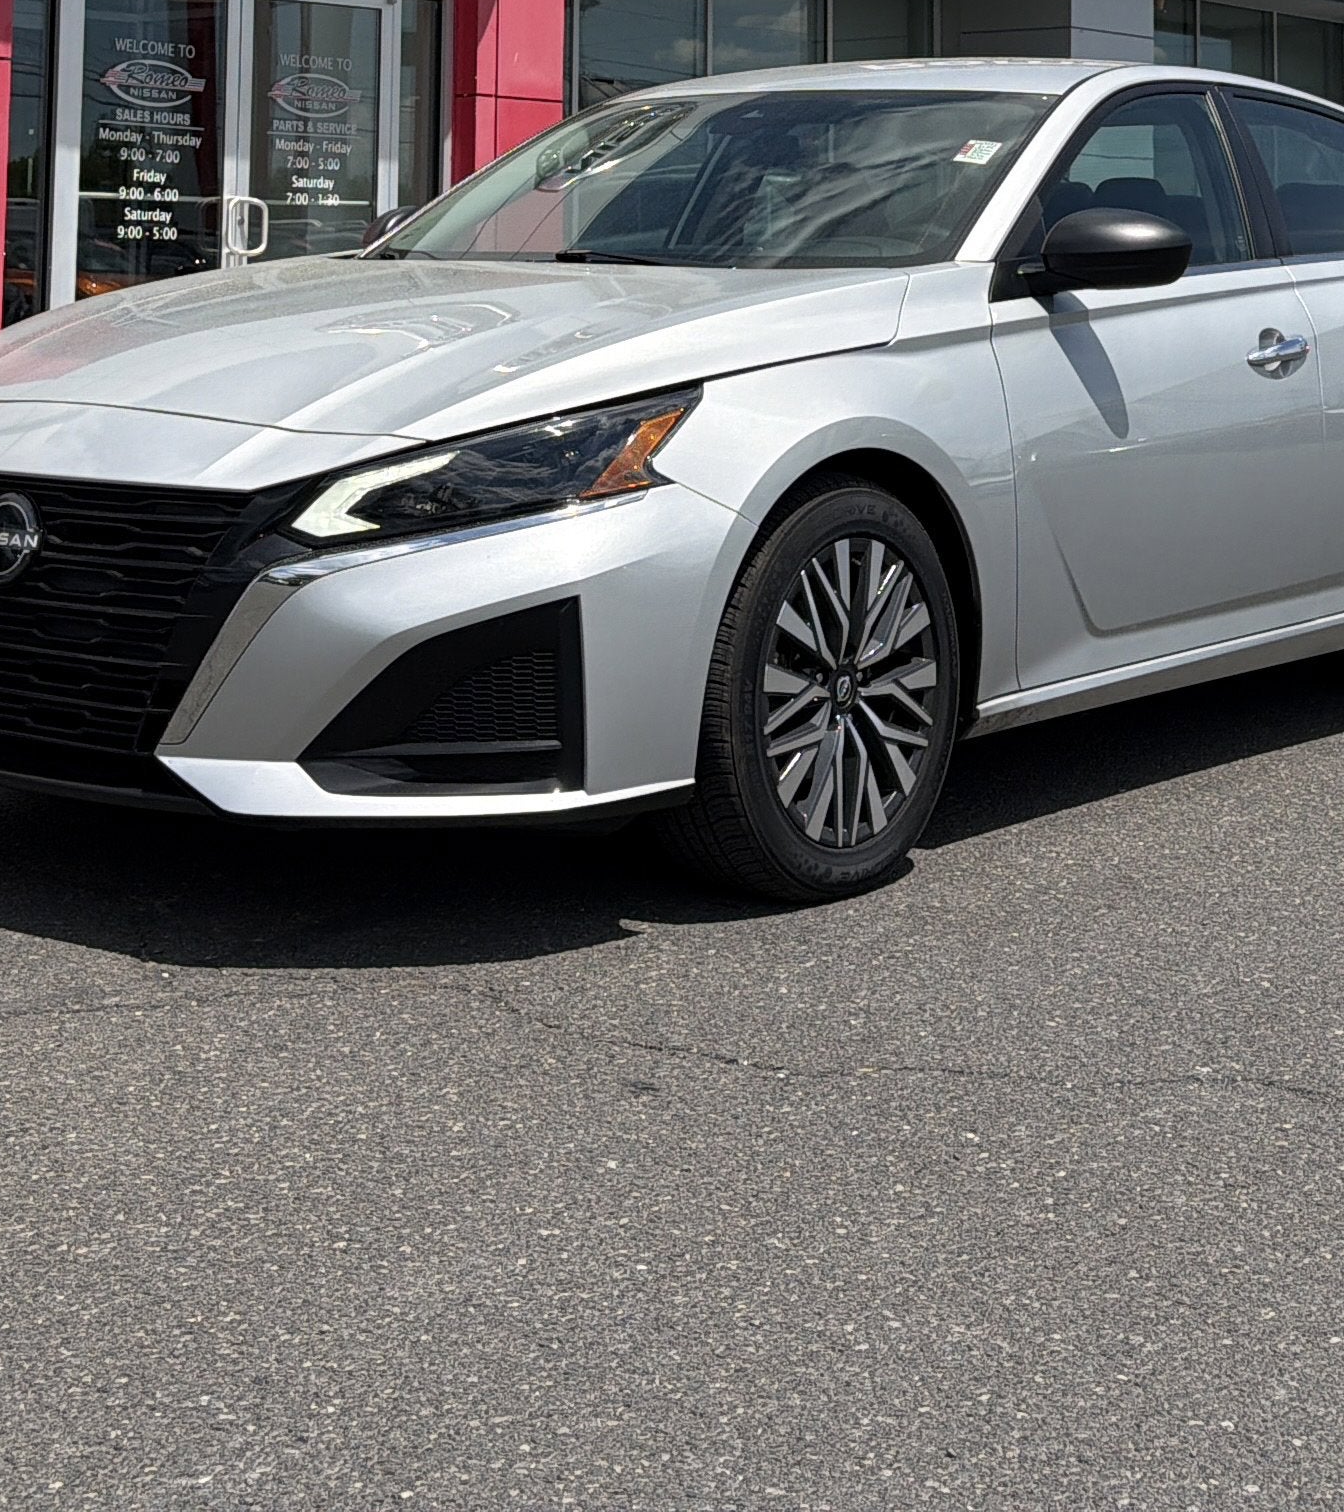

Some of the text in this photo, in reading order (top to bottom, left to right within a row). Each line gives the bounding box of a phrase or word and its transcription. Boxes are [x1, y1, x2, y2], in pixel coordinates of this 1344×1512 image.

[115, 38, 196, 59] WELCOME TO
[279, 54, 352, 71] WELCOME TO
[120, 62, 189, 88] Romeo
[130, 87, 177, 100] NISSAN
[289, 76, 347, 99] Romeo
[294, 100, 337, 111] NISSAN
[116, 109, 191, 126] SALES HOURS
[273, 120, 358, 135] PARTS & SERVICE
[99, 128, 144, 144] Monday
[152, 131, 203, 149] Thursday
[120, 147, 146, 161] 9:00
[156, 150, 181, 163] 7:00
[276, 139, 315, 154] Monday
[322, 141, 353, 156] Friday
[287, 156, 310, 169] 7:00
[318, 158, 341, 170] 5:00
[132, 169, 167, 185] Friday
[292, 175, 335, 190] Saturday
[118, 186, 145, 200] 9:00
[154, 188, 179, 201] 6:00
[286, 192, 309, 205] 7:00
[318, 194, 340, 206] 1:30
[124, 207, 173, 224] Saturday
[117, 226, 143, 239] 9:00
[152, 227, 178, 240] 5:00
